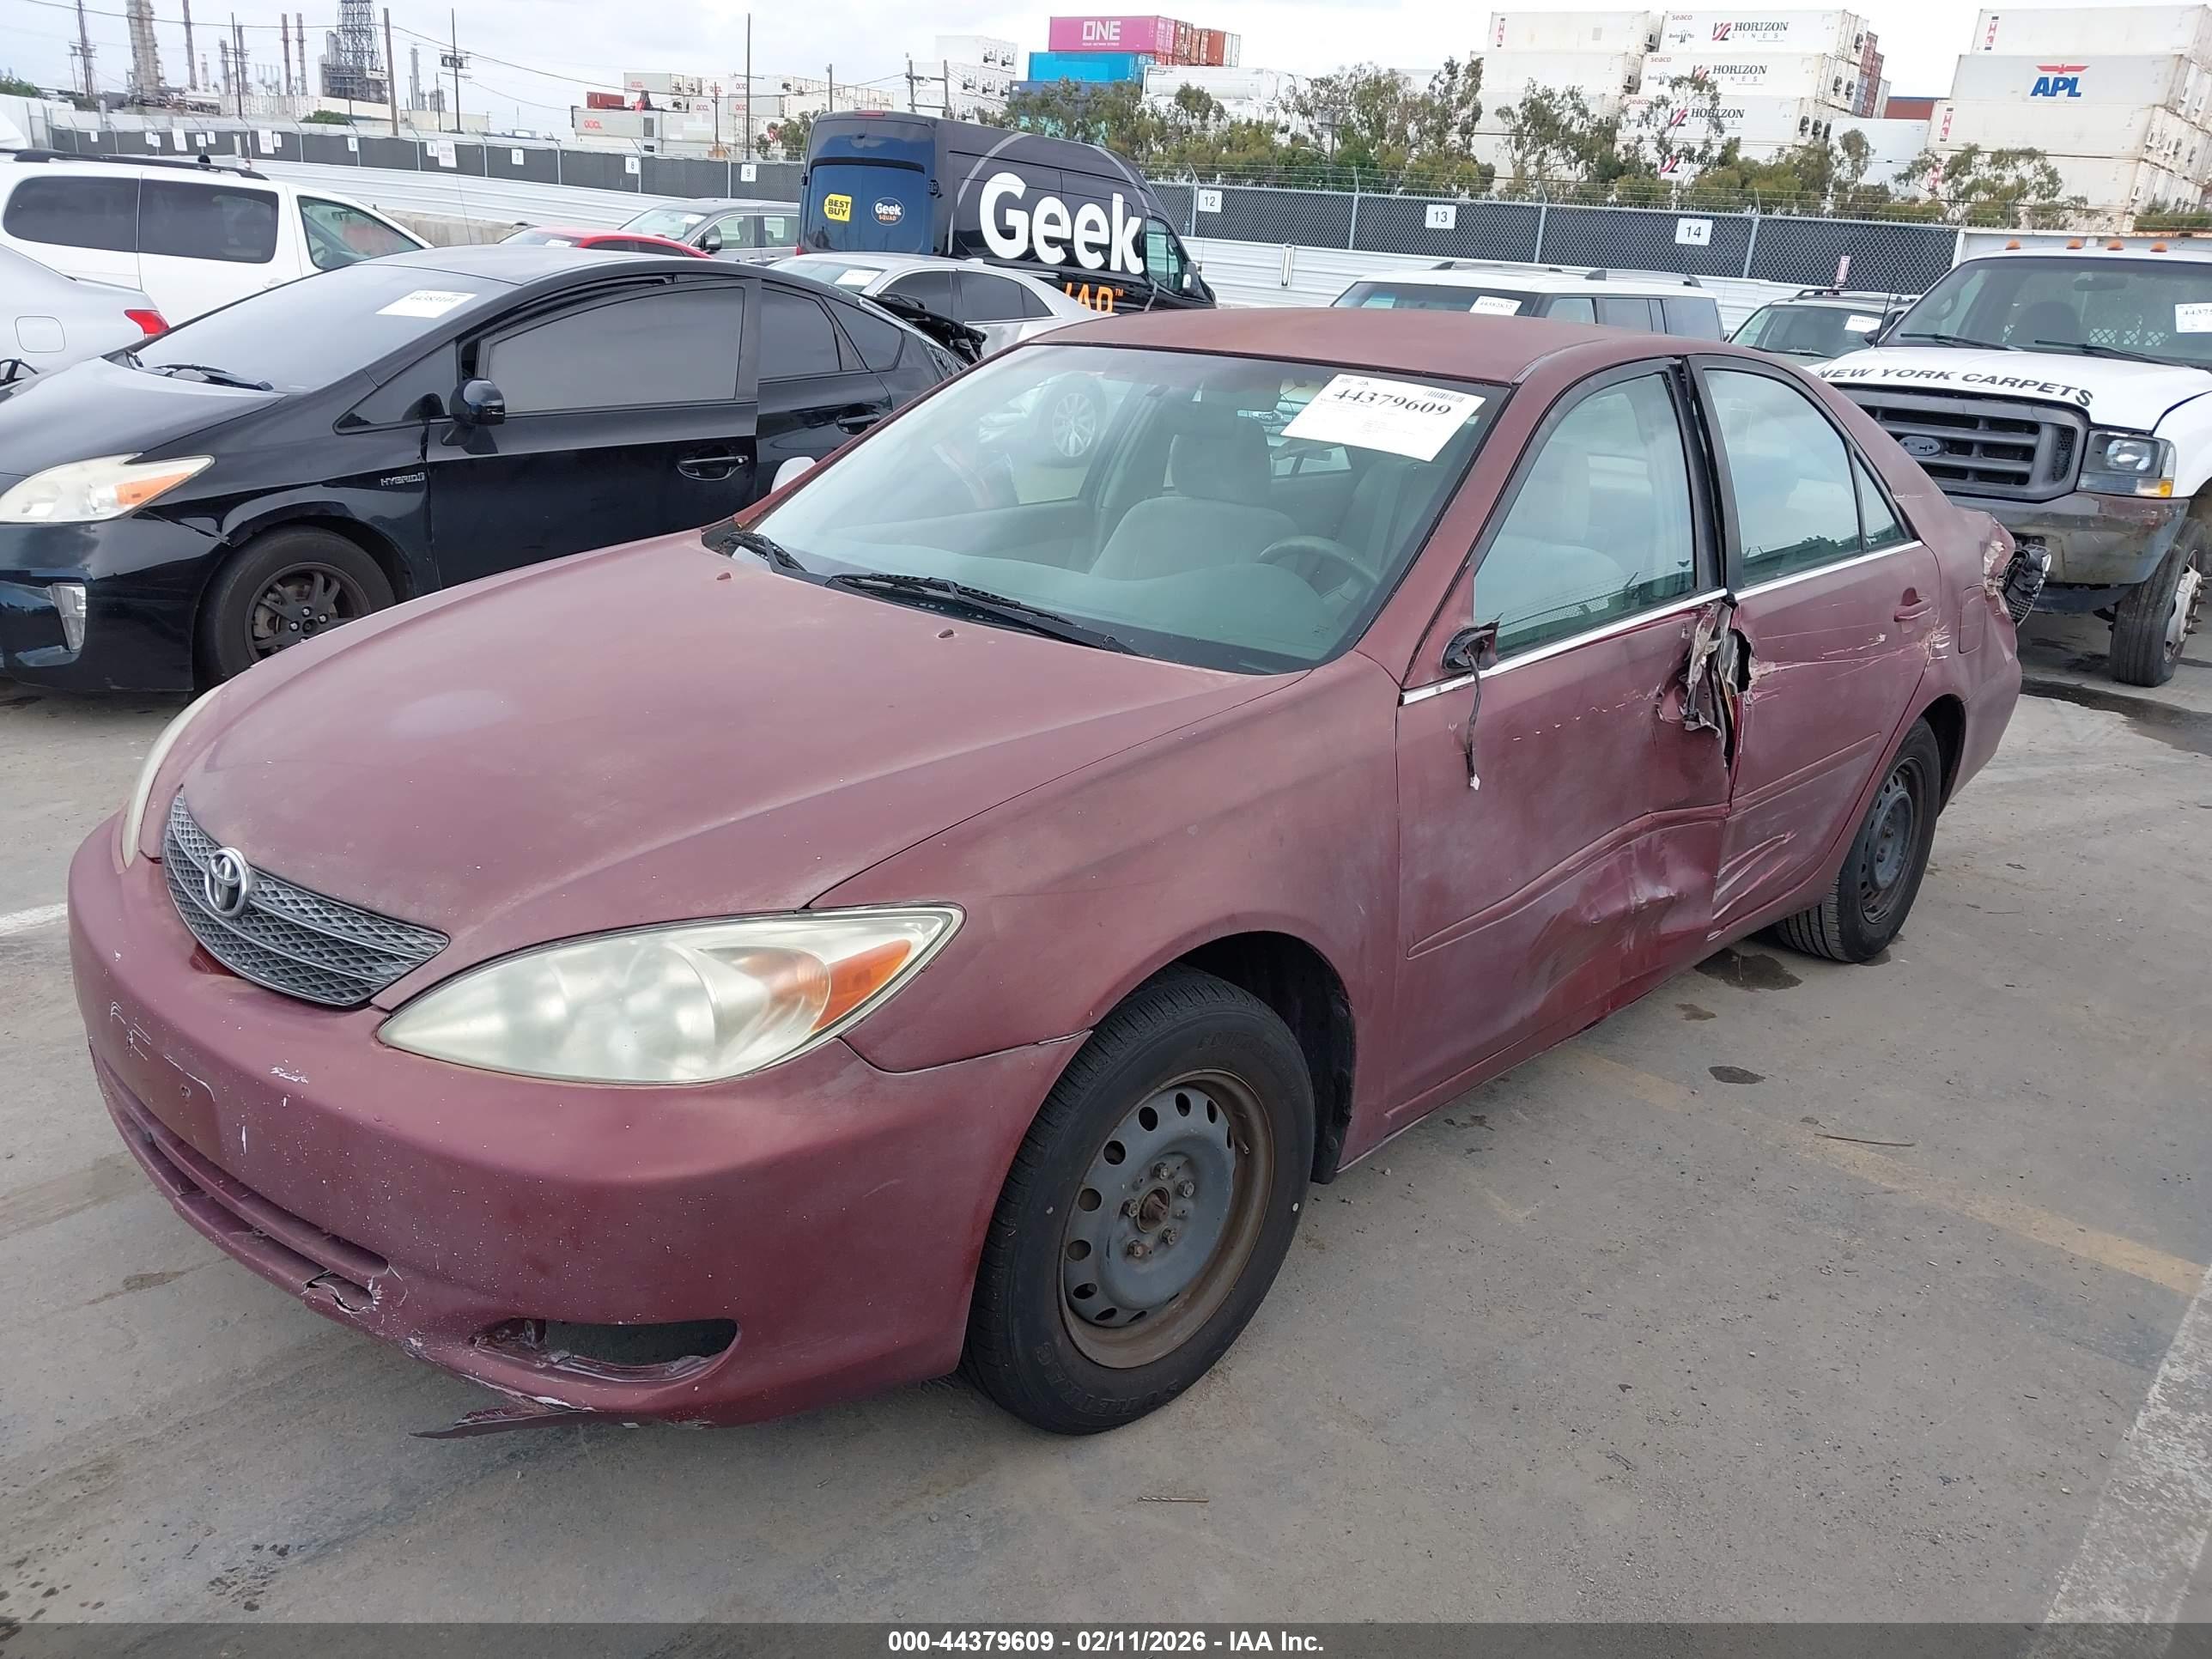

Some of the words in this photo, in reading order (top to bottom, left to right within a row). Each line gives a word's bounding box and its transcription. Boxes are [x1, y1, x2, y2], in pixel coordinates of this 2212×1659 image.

[1083, 21, 1121, 40] ONE
[1733, 22, 1790, 32] HORIZON
[1712, 64, 1768, 75] HORIZON
[2030, 76, 2081, 97] APL
[746, 168, 750, 177] 9
[828, 198, 850, 209] BEST
[1204, 196, 1216, 207] 12
[828, 207, 848, 216] BUY
[875, 202, 902, 216] Geek
[1434, 210, 1448, 222] 13
[979, 172, 1145, 275] Geek
[1686, 225, 1702, 238] 14
[1816, 368, 1875, 379] NEW
[1881, 368, 1959, 380] YORK
[1961, 373, 2094, 407] CARPETS
[1333, 388, 1452, 416] 44379609
[380, 474, 417, 487] HYBRID
